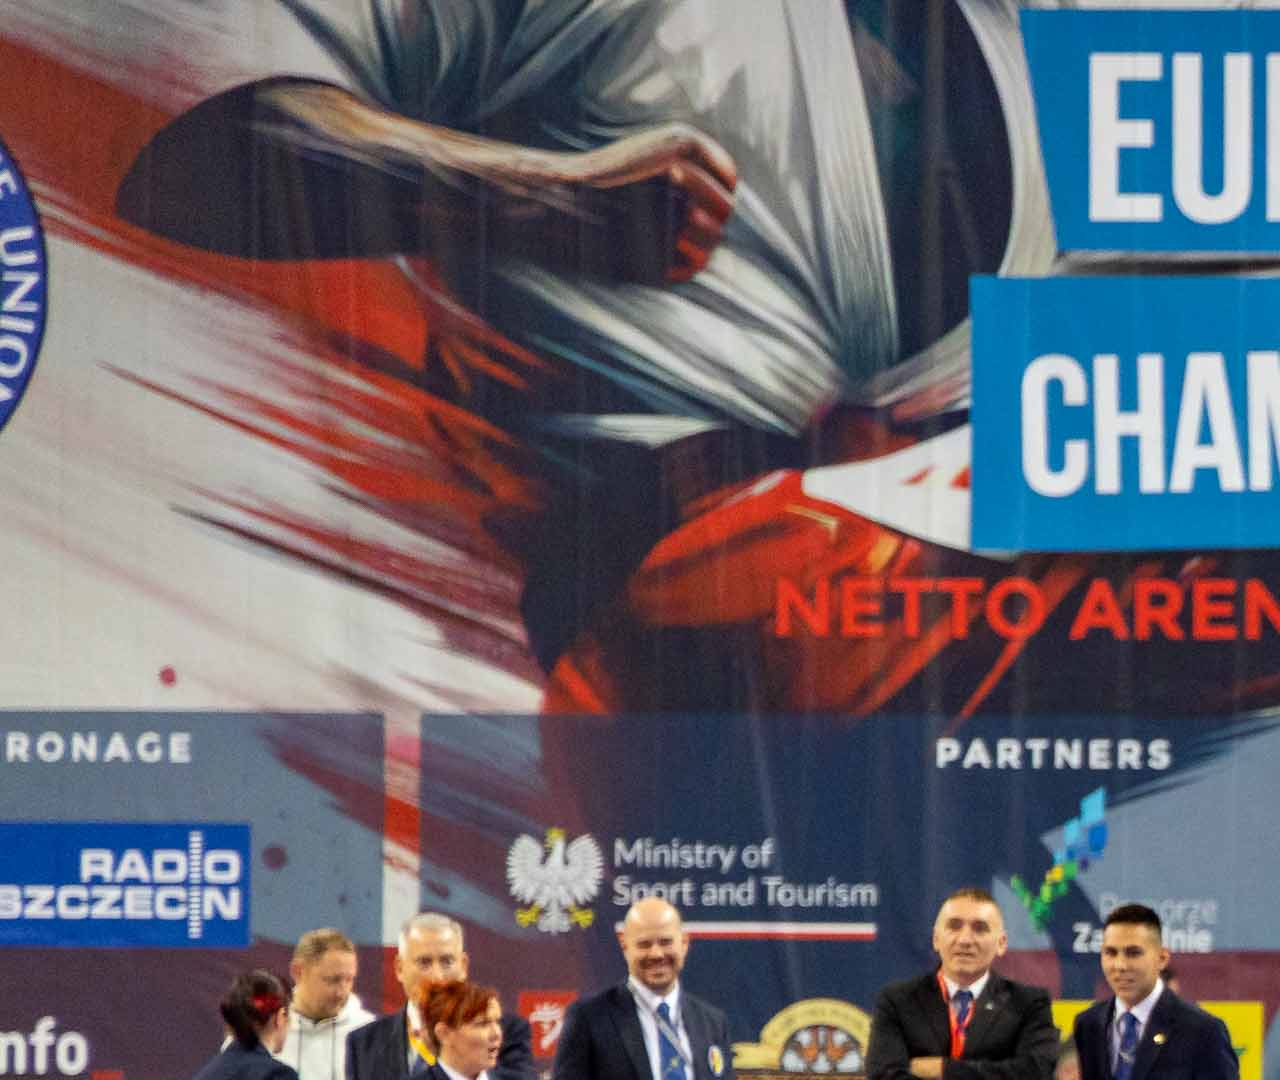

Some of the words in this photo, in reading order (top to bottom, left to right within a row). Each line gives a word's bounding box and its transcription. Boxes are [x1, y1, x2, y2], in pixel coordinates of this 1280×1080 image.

[774, 576, 1049, 641] NETTO
[935, 737, 1172, 771] PARTNERS
[79, 847, 242, 885] RADIO
[613, 837, 737, 874] Ministry
[741, 836, 777, 869] of
[701, 876, 756, 907] and
[762, 875, 878, 908] Tourism
